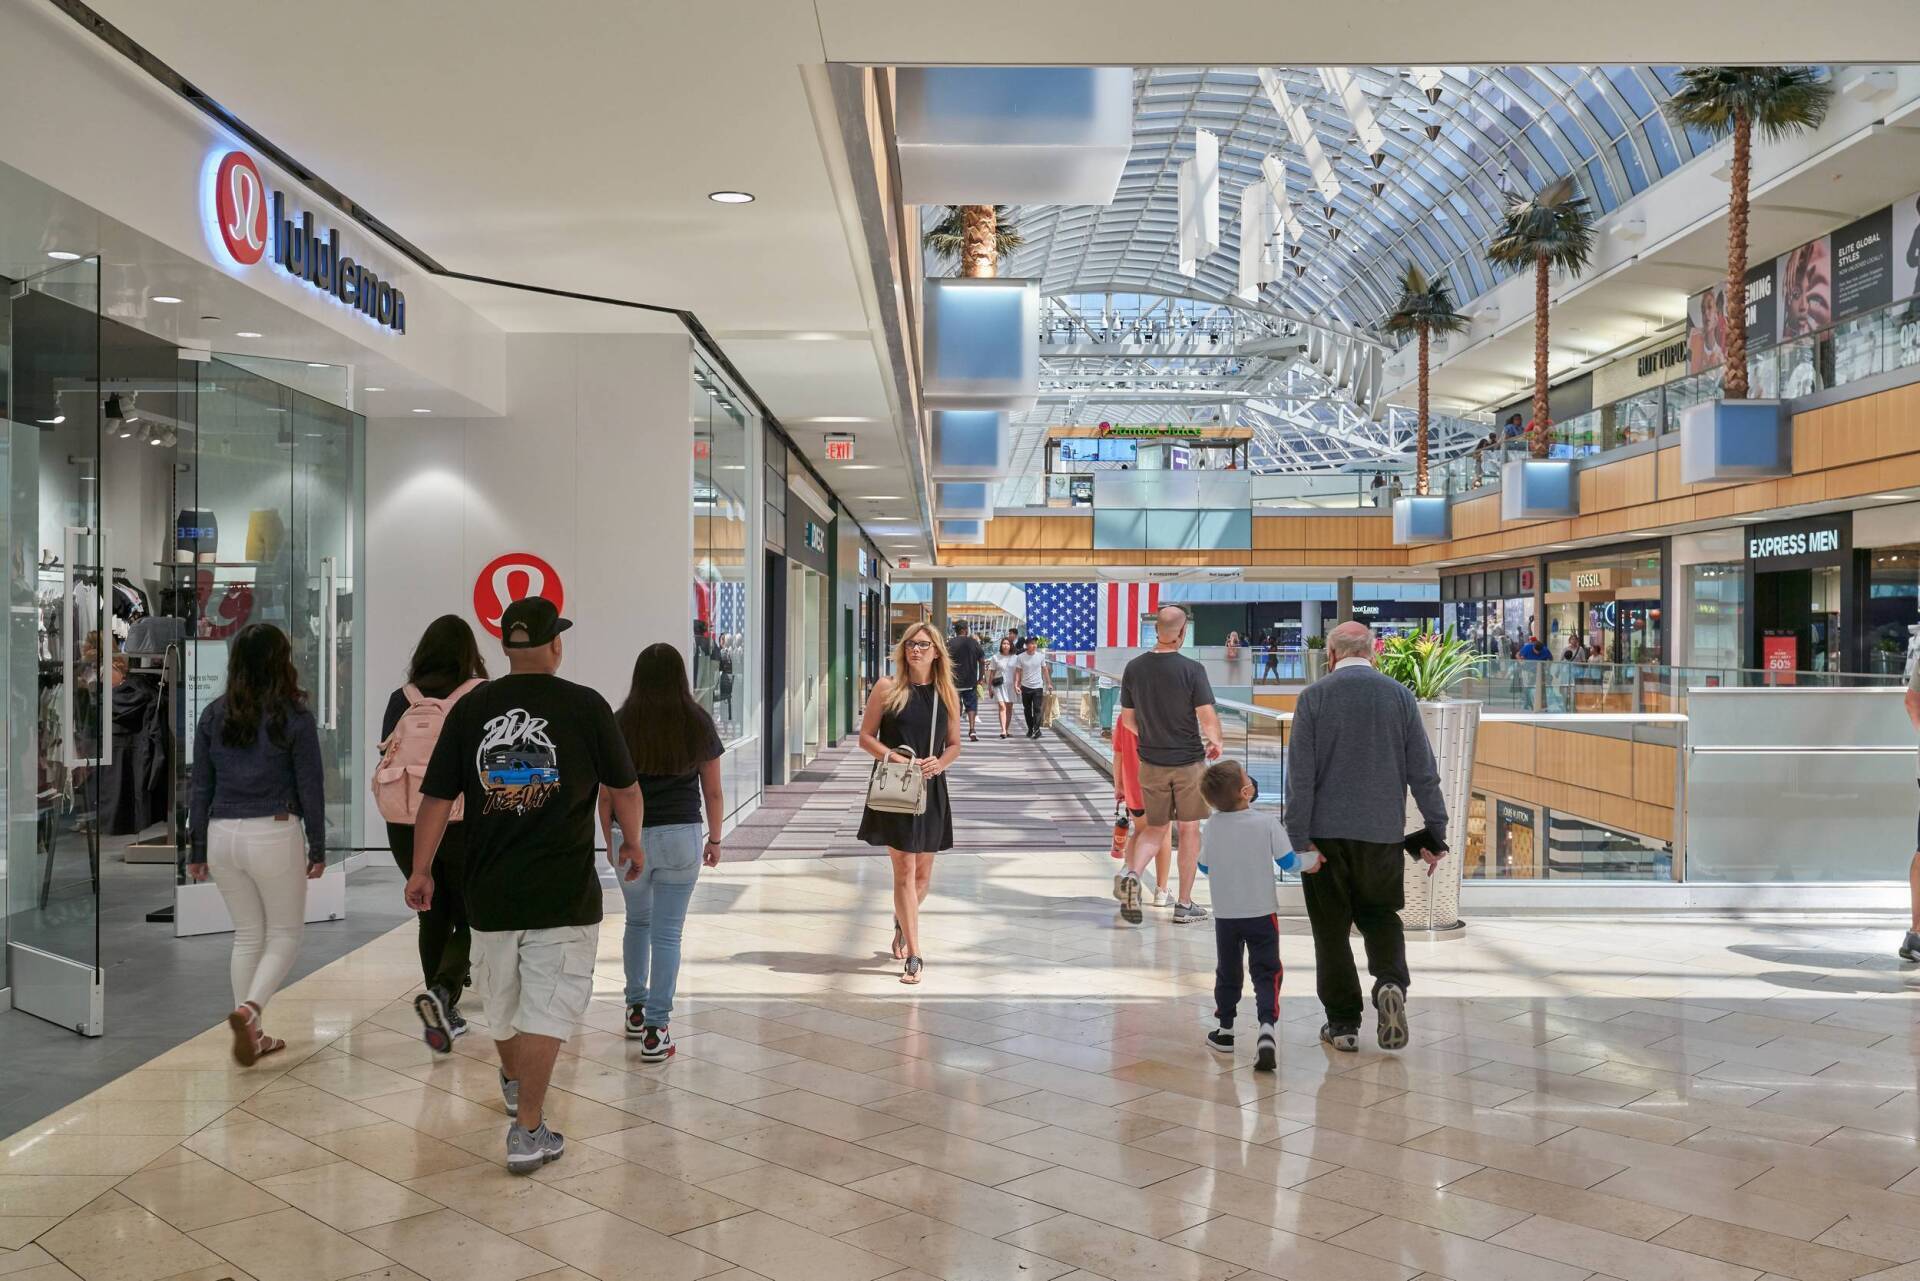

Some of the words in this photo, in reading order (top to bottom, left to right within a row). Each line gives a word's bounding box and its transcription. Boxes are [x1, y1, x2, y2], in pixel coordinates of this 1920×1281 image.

[1838, 243, 1855, 257] ELITE
[1855, 232, 1880, 249] GLOBAL
[273, 190, 406, 336] lululemon
[1838, 251, 1860, 267] STYLES
[830, 442, 850, 459] EXIT
[1750, 533, 1806, 558] EXPRESS
[1809, 528, 1838, 552] MEN
[1577, 573, 1600, 588] FOSSIL
[1770, 658, 1792, 670] 50%
